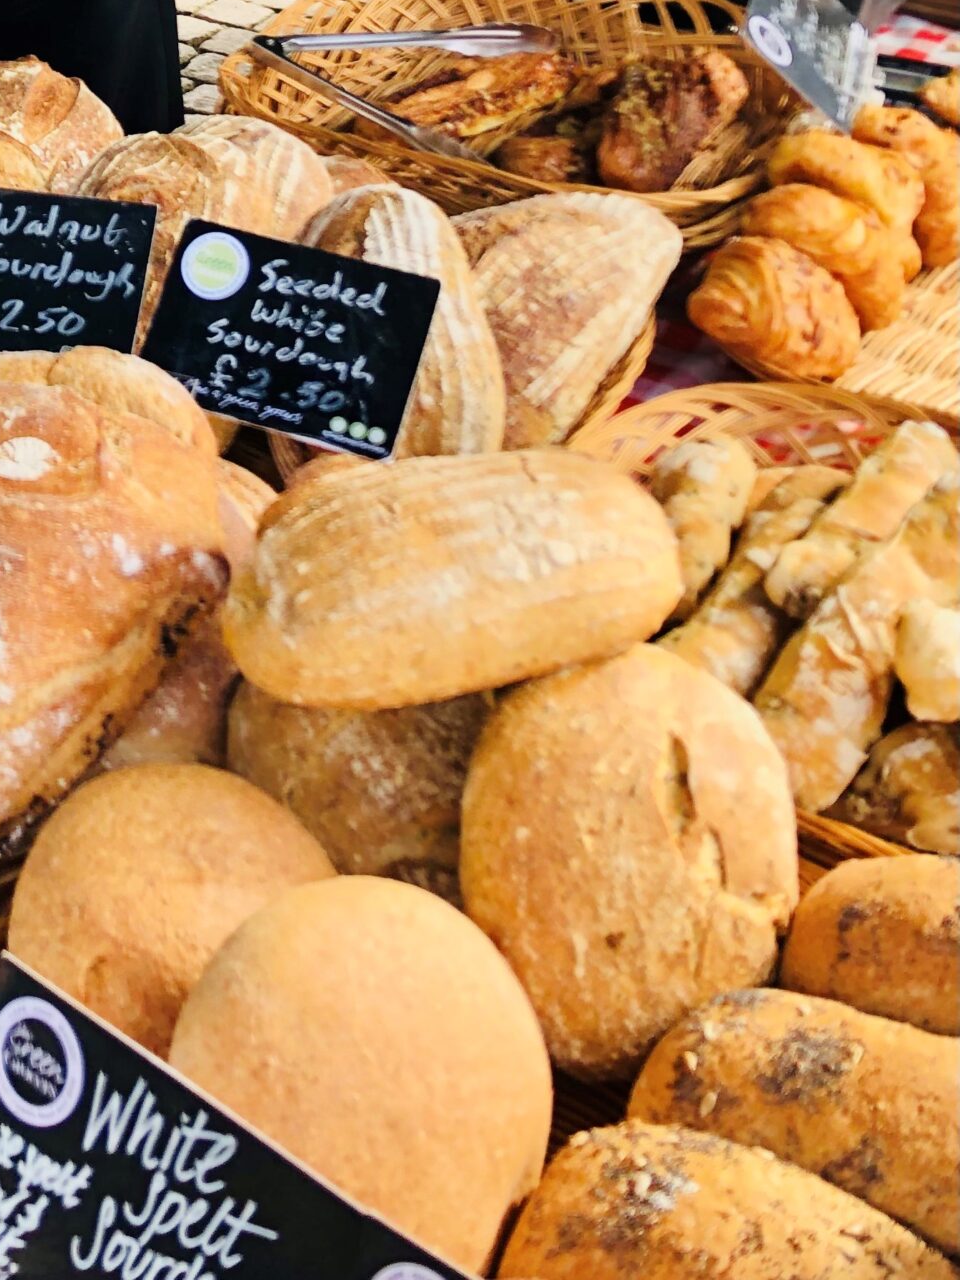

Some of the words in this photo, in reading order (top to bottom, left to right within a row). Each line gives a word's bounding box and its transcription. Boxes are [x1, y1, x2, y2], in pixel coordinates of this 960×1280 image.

[258, 259, 388, 316] Seeded
[206, 318, 375, 386] Sourdough
[251, 298, 346, 344] White
[208, 354, 345, 412] £2.50
[82, 1070, 237, 1193] White
[123, 1167, 279, 1266] Spelt
